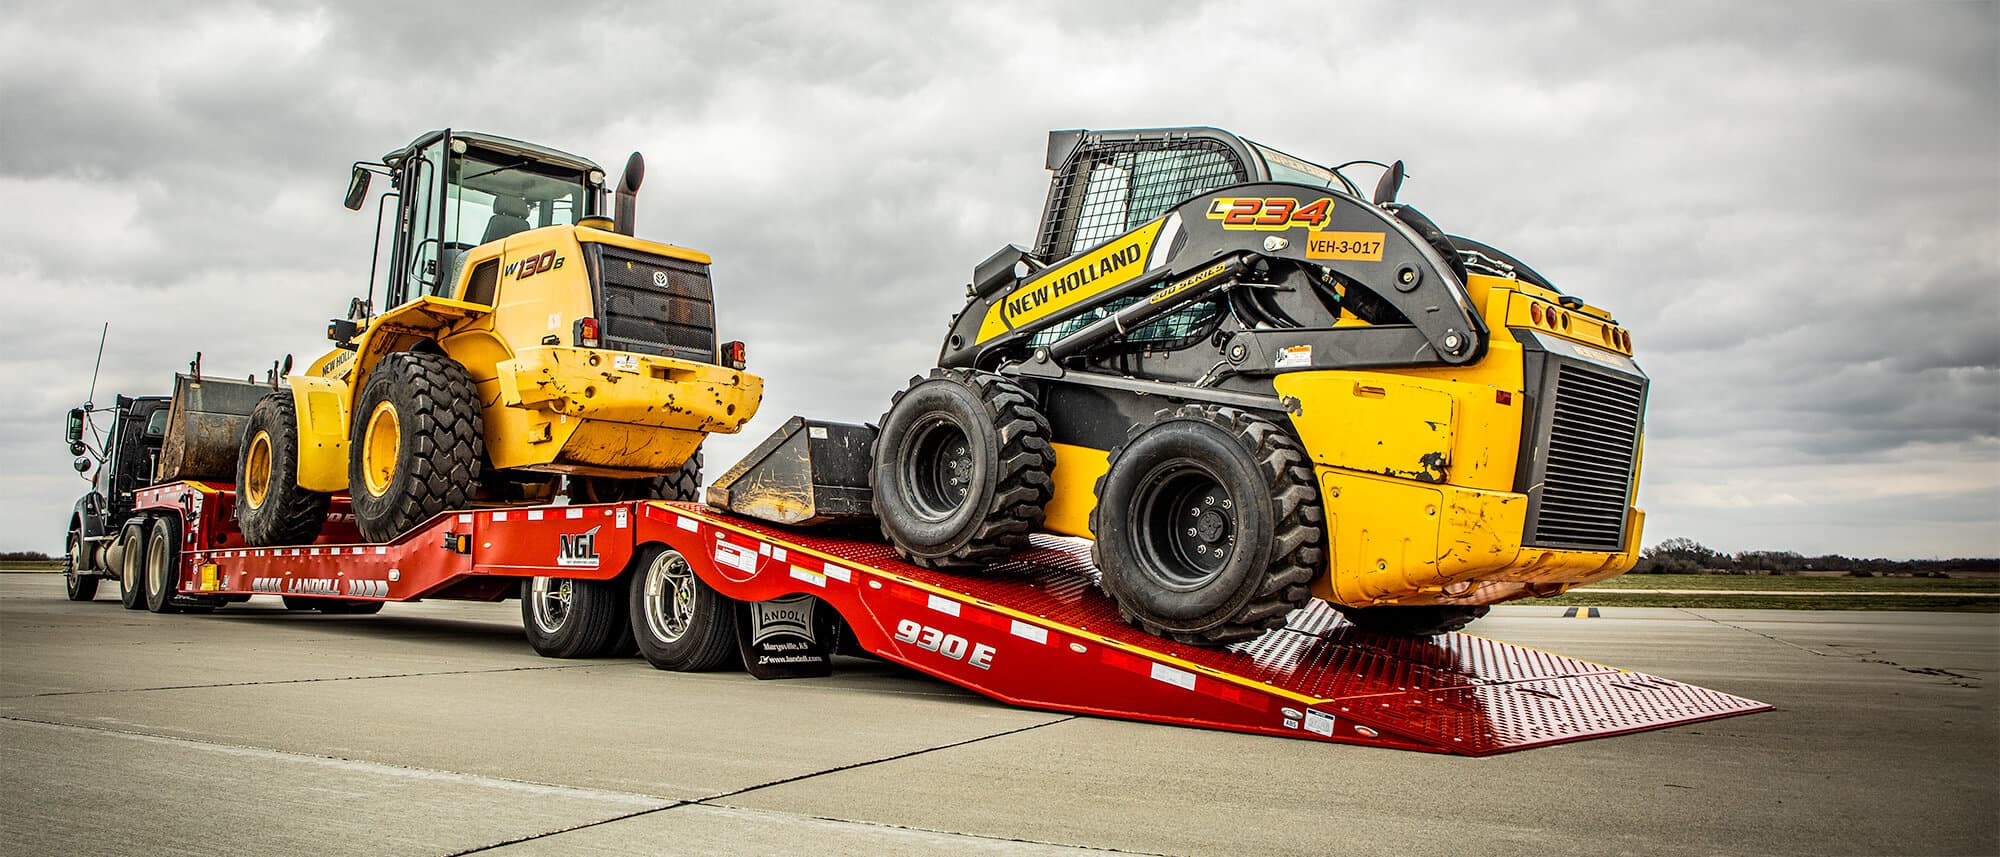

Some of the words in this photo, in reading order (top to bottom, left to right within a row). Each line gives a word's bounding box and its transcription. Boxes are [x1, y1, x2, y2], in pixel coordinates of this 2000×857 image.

[1208, 199, 1332, 228] L234
[1310, 240, 1381, 255] VEH-3-017
[1008, 286, 1049, 318] NEW
[1053, 243, 1141, 298] HOLLAND
[1179, 264, 1224, 290] SERIES
[322, 359, 336, 378] NEW
[560, 533, 600, 559] NGL
[287, 578, 341, 595] LANDOLL
[763, 642, 799, 652] Marysville,
[895, 618, 968, 661] 930
[967, 642, 997, 671] E
[768, 655, 822, 664] www.landoll.com
